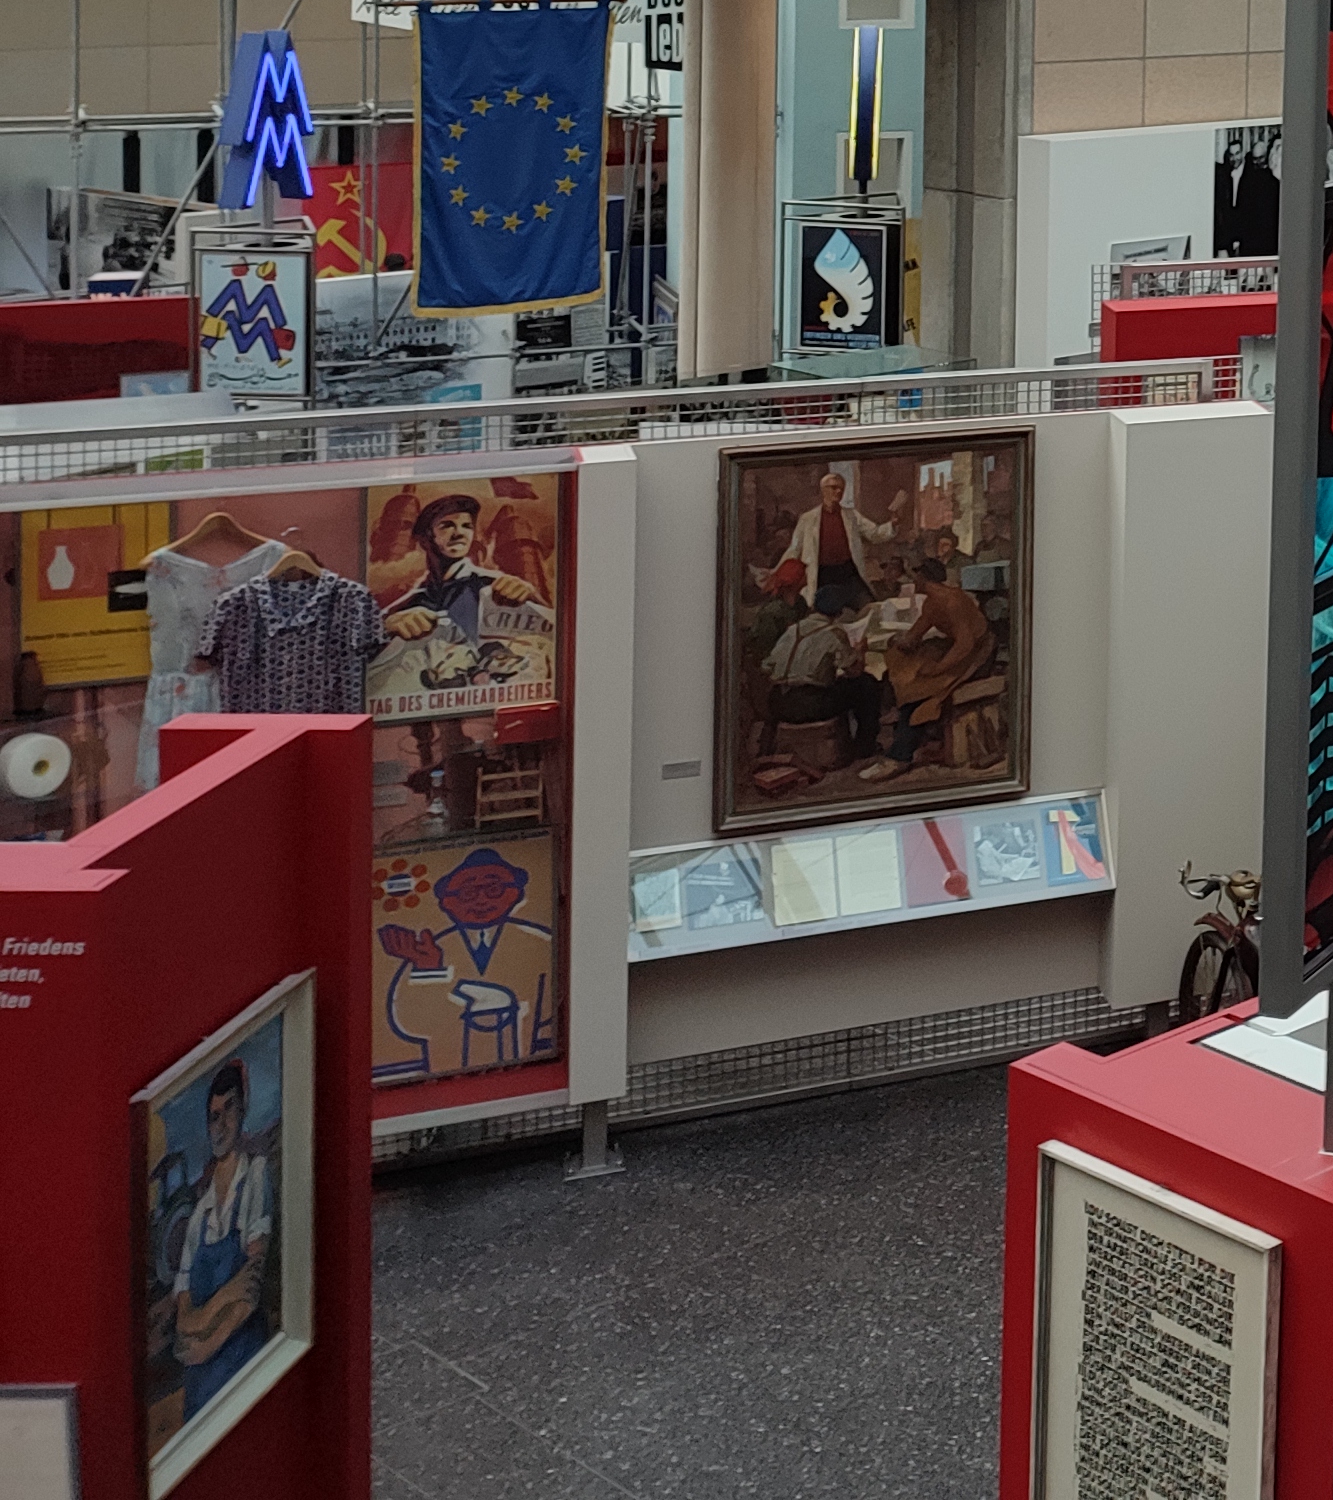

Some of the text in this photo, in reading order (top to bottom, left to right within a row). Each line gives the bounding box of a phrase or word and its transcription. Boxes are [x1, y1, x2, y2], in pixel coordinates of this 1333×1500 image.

[370, 681, 553, 716] TAG DES CHEMIEARBEITERS
[2, 937, 86, 956] Friedens
